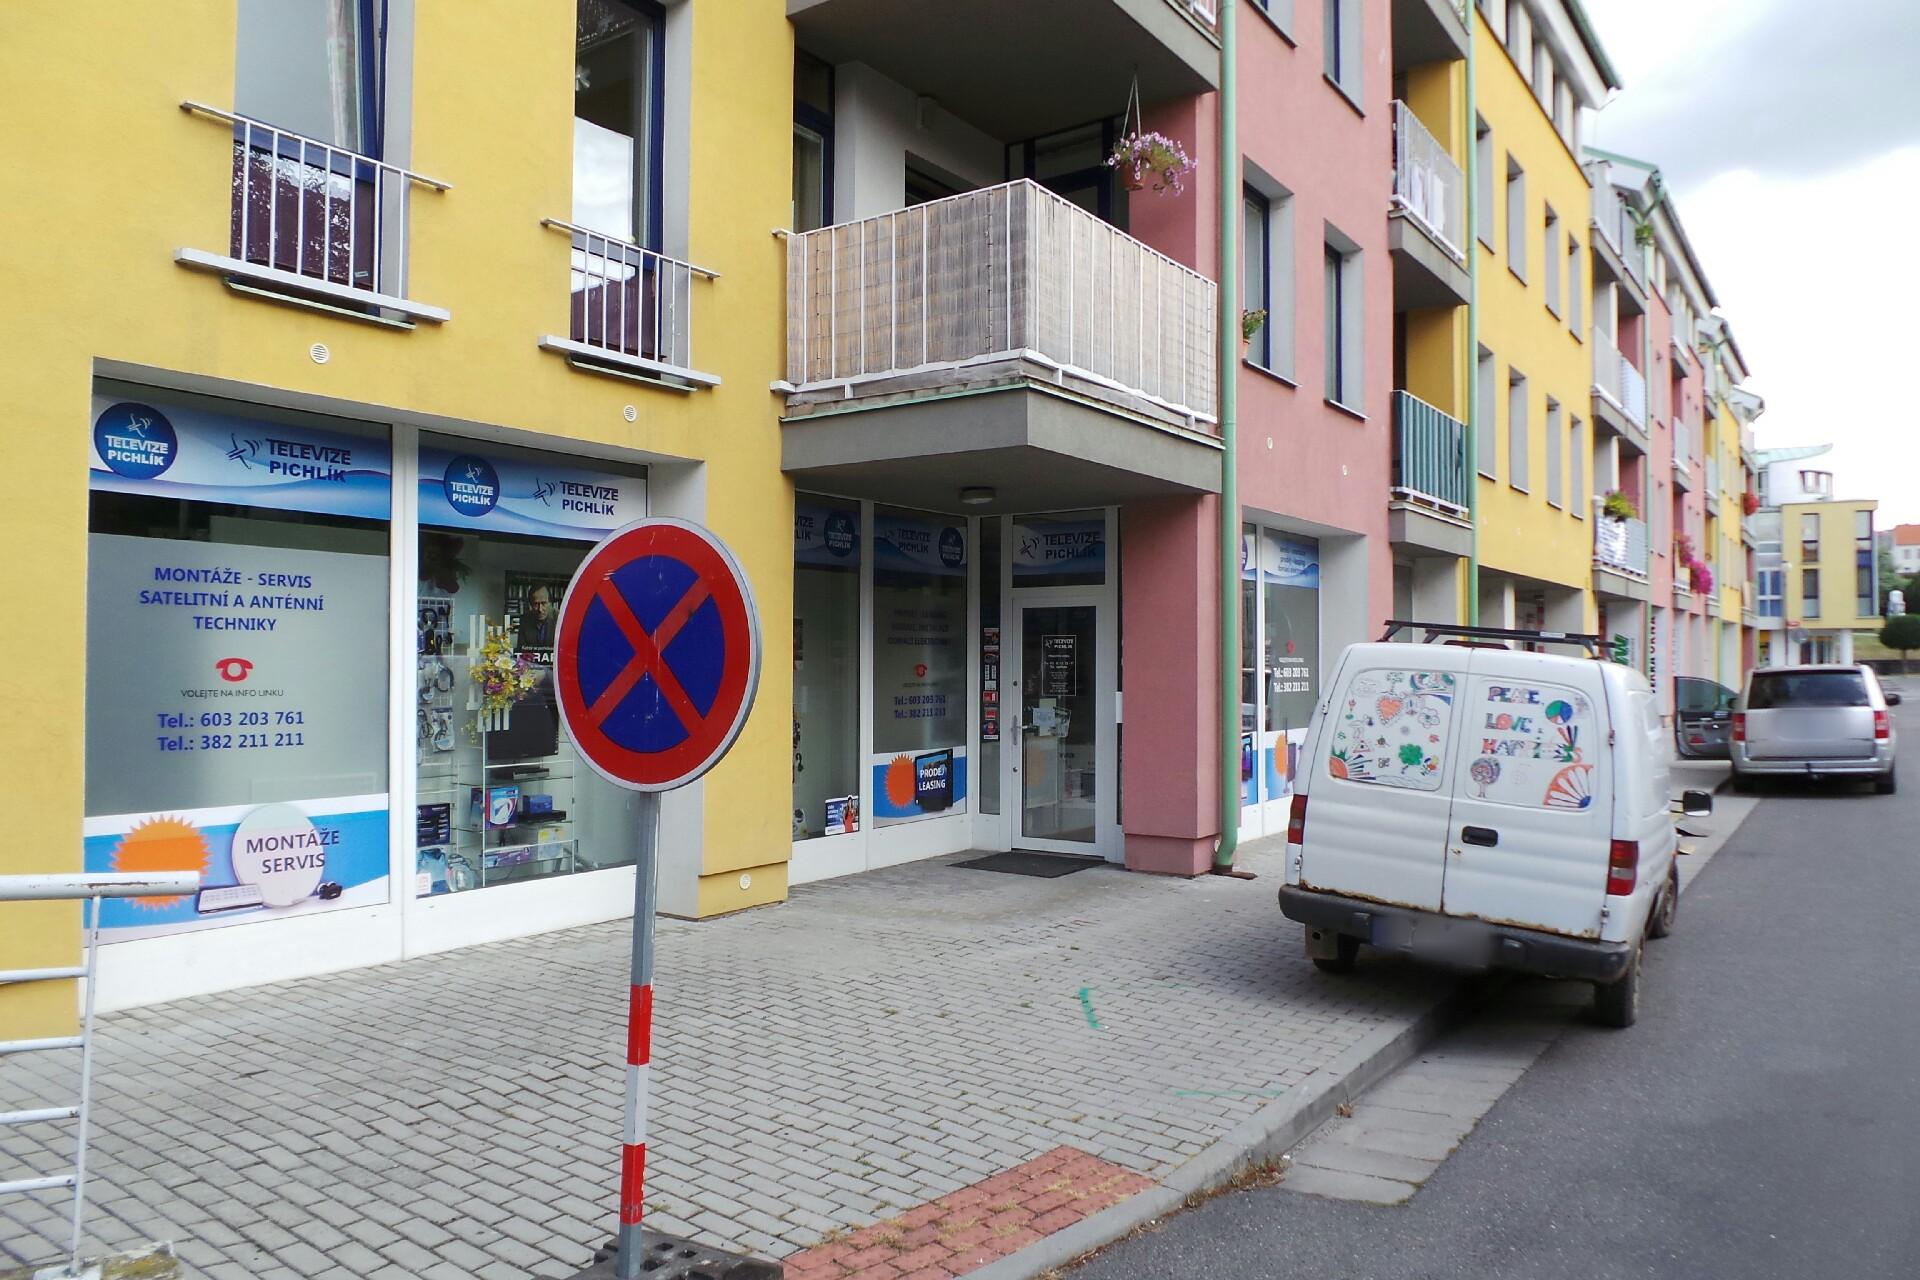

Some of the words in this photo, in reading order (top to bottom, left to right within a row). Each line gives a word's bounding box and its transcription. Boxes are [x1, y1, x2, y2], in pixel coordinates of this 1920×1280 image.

[105, 435, 168, 454] TELEVIZE
[266, 438, 351, 465] TELEVIZE
[107, 449, 164, 466] PICHLÍK
[269, 460, 346, 483] PICHLÍK
[451, 481, 494, 496] TELEVIZE
[560, 481, 619, 501] TELEVIZE
[452, 493, 491, 506] PICHLÍK
[562, 499, 615, 516] PICHLÍK
[1043, 532, 1099, 546] TELEVIZE
[1046, 548, 1097, 560] PICHLÍK
[154, 566, 241, 585] MONTÁŽE
[258, 573, 312, 589] SERVIS
[140, 589, 228, 607] SATELITNÍ
[233, 595, 244, 607] A
[250, 594, 324, 611] ANTÉNNÍ
[193, 616, 276, 631] TECHNIKY
[181, 688, 218, 699] VOLEJTE
[220, 689, 233, 697] NA
[235, 689, 256, 697] INFO
[258, 689, 284, 697] LINKU
[157, 713, 194, 728] Tel.:
[201, 712, 232, 727] 603
[239, 712, 269, 726] 203
[275, 711, 304, 725] 761
[157, 736, 194, 751] Tel.:
[200, 735, 232, 749] 382
[239, 734, 267, 748] 211
[274, 733, 304, 746] 211
[920, 766, 946, 779] PRODEJ
[918, 778, 946, 791] LEASING
[246, 829, 339, 854] MONTÁŽE
[261, 852, 325, 874] SERVIS
